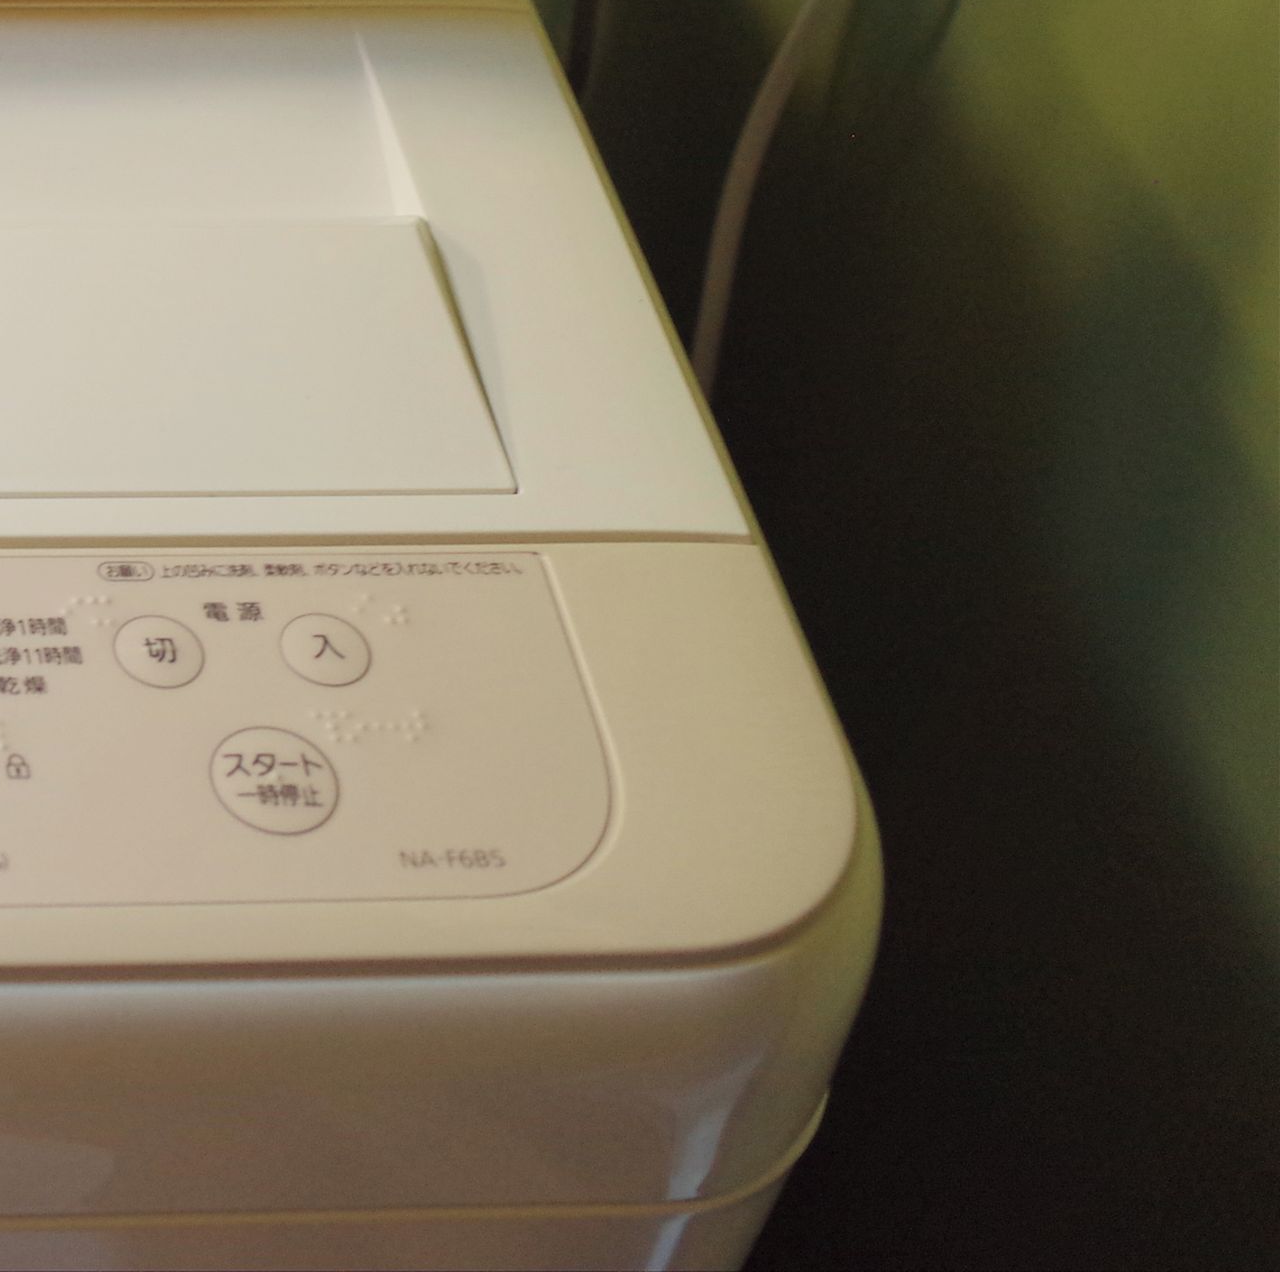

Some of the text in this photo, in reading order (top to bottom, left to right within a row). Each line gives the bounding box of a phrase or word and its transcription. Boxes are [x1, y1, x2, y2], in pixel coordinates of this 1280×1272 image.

[202, 601, 263, 623] 電源
[143, 636, 179, 664] 切
[311, 632, 347, 661] 入
[223, 752, 324, 778] スタート
[237, 782, 325, 808] 一時停止
